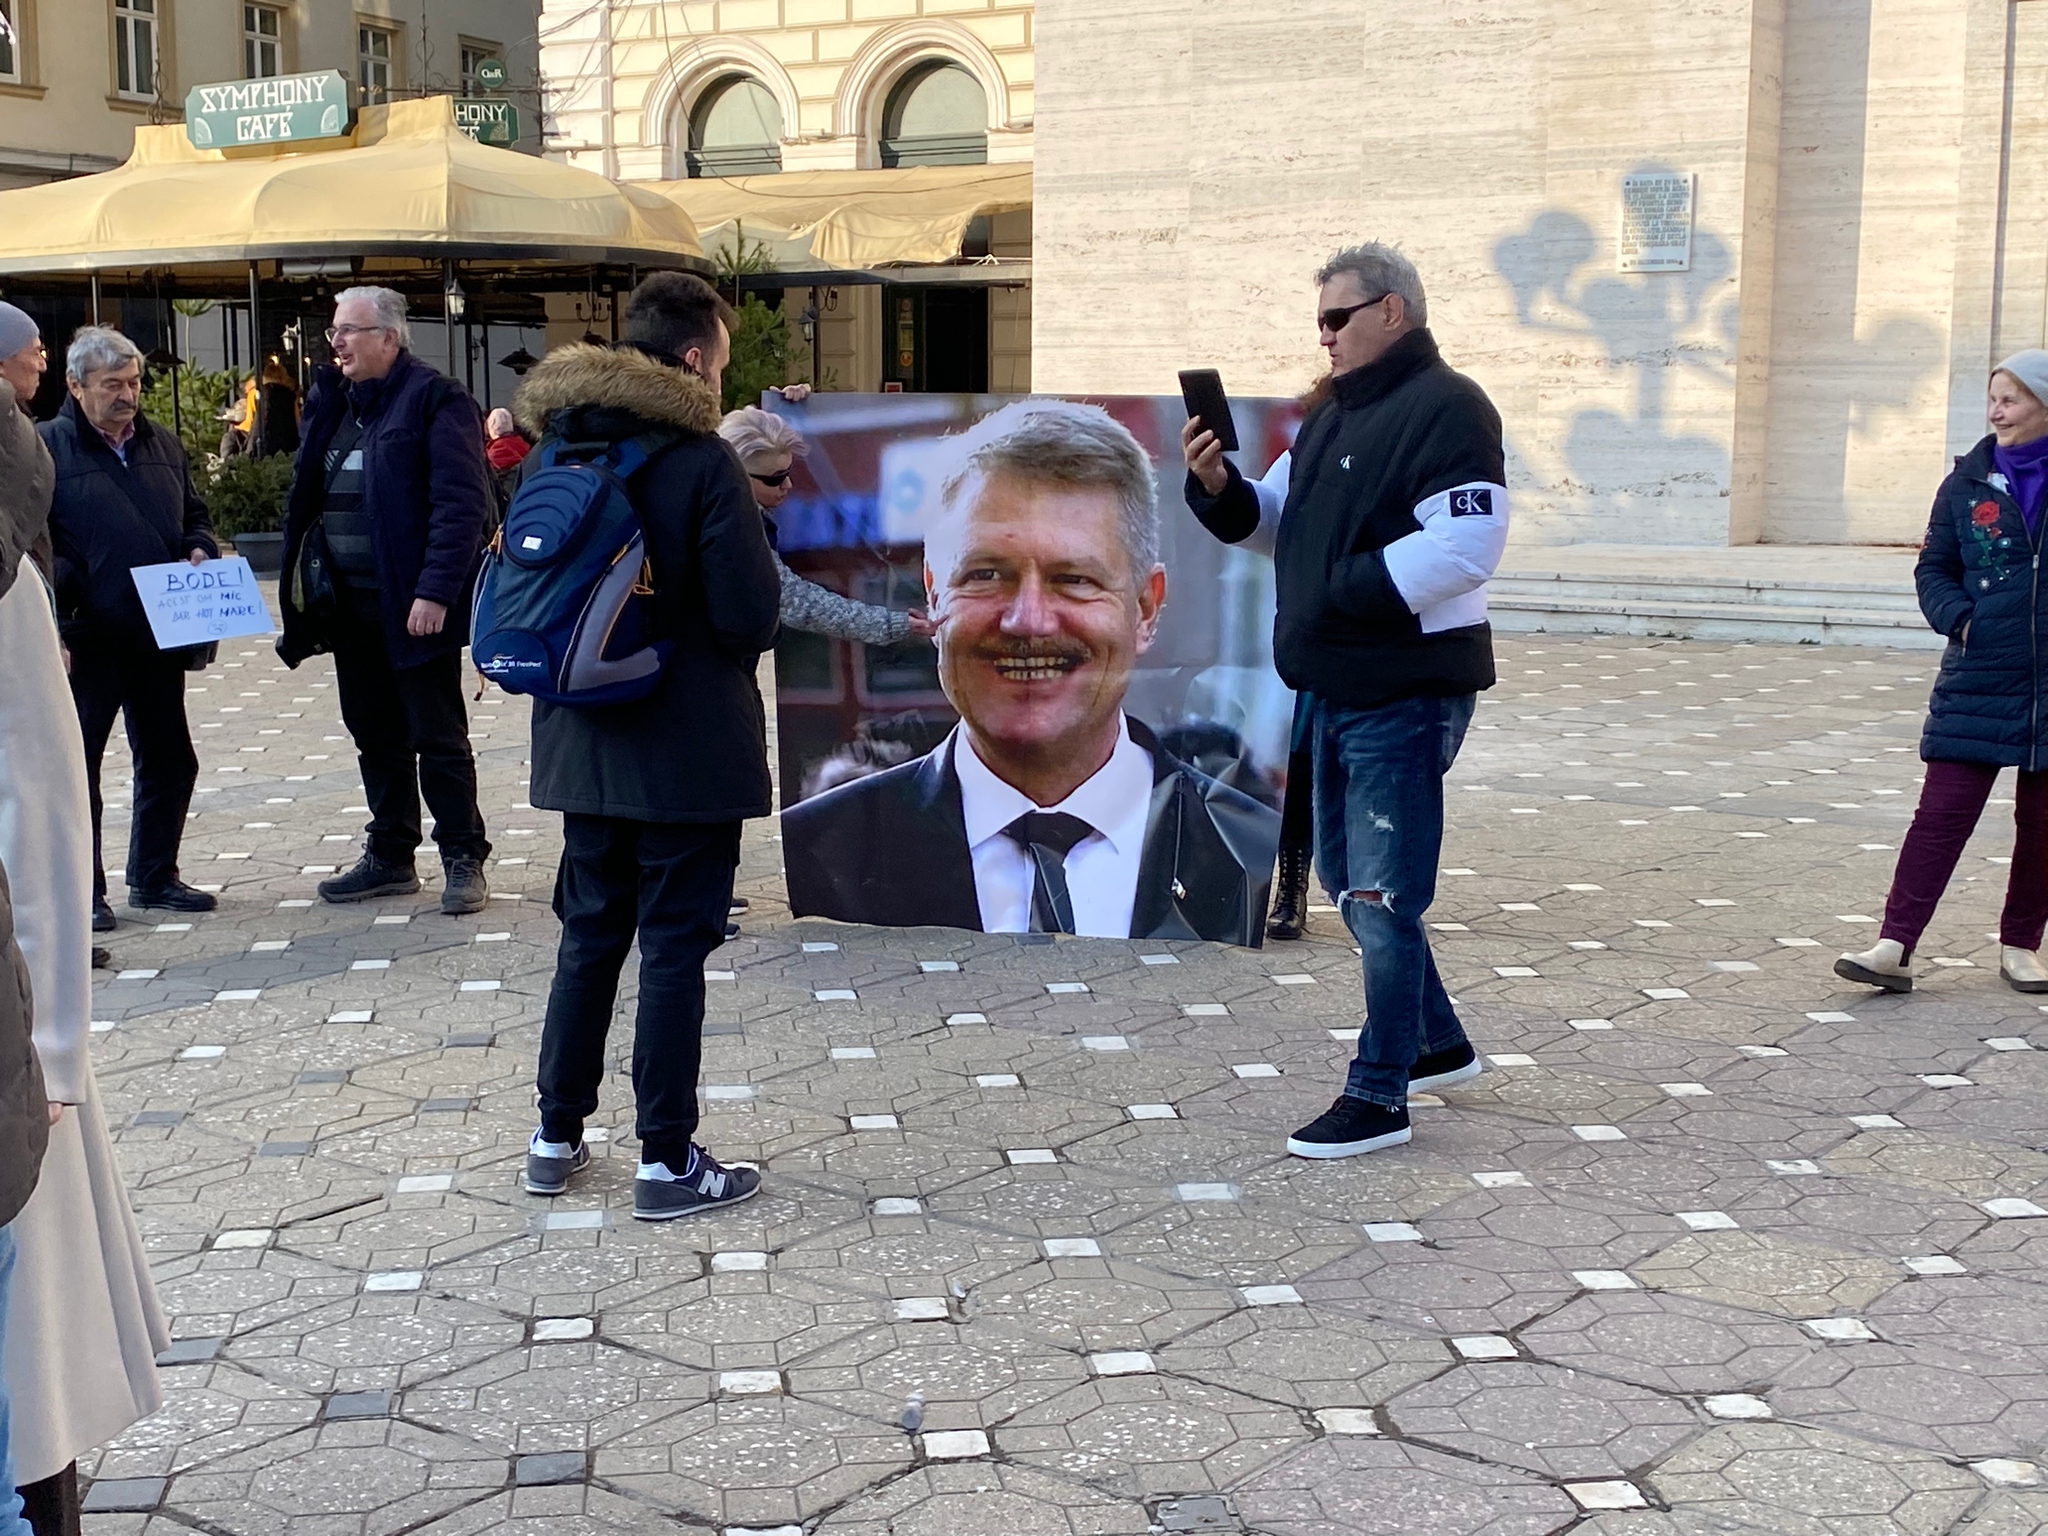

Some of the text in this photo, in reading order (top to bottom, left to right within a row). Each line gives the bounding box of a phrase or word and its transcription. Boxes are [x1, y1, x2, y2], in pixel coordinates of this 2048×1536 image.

[199, 75, 330, 114] SYMPHONY
[236, 105, 294, 141] CAFÉ
[697, 1169, 726, 1198] N
